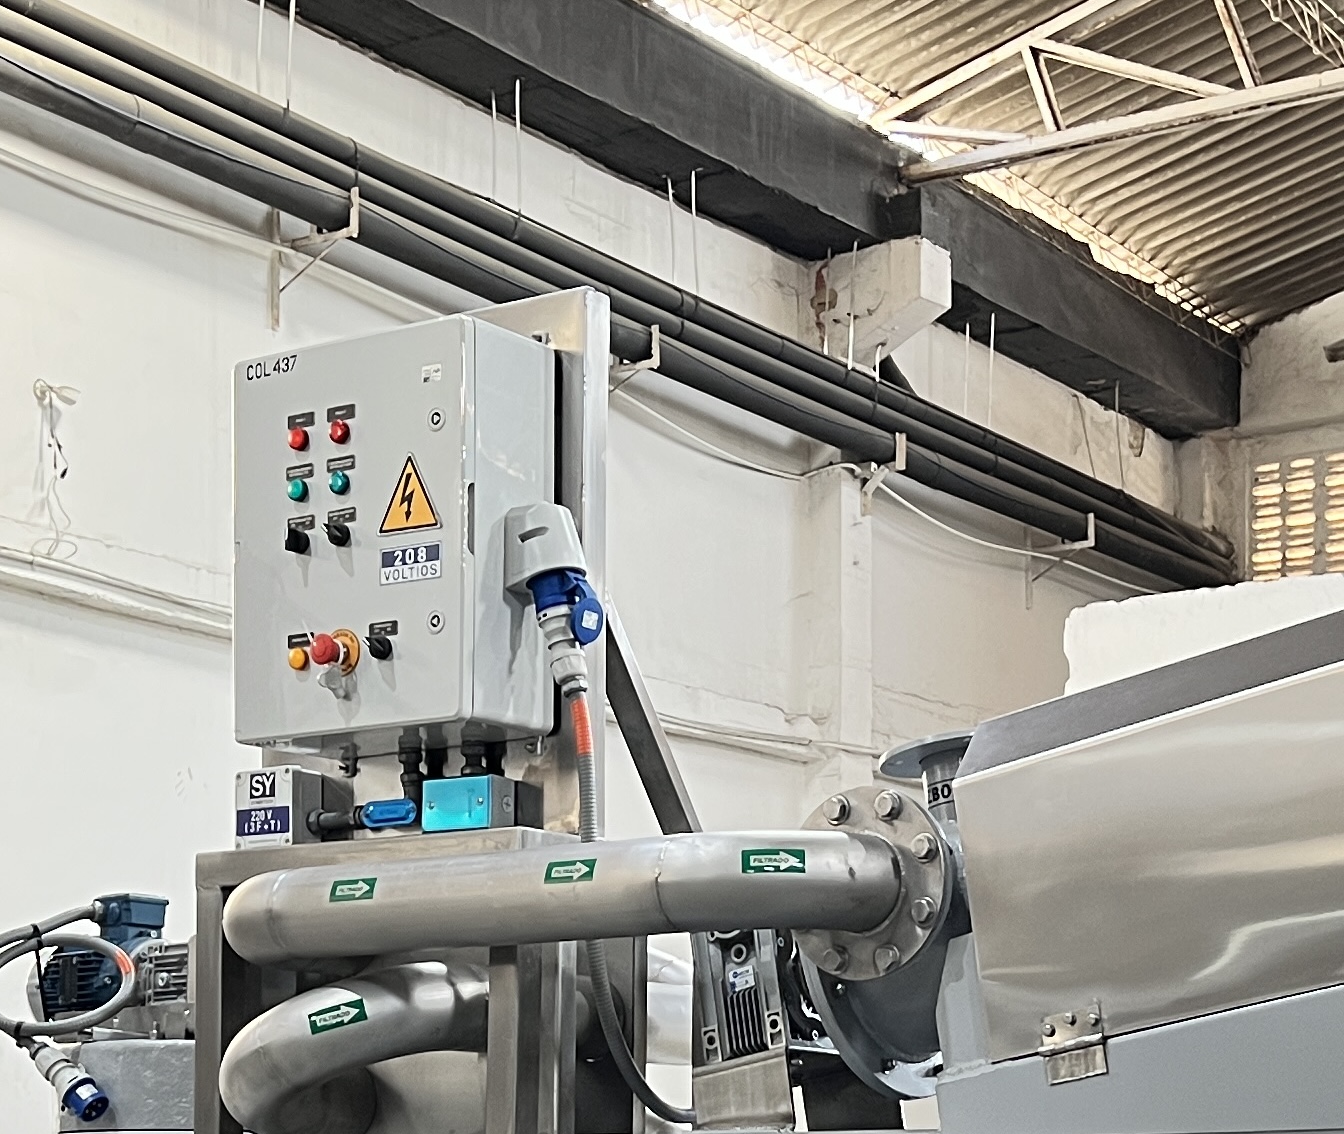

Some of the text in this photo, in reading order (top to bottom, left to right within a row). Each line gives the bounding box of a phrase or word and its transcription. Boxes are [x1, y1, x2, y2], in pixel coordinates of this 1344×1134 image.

[246, 354, 297, 380] COL 437
[393, 546, 427, 567] 208
[383, 563, 438, 581] VOLTIOS
[251, 774, 275, 797] SY
[266, 809, 273, 820] V
